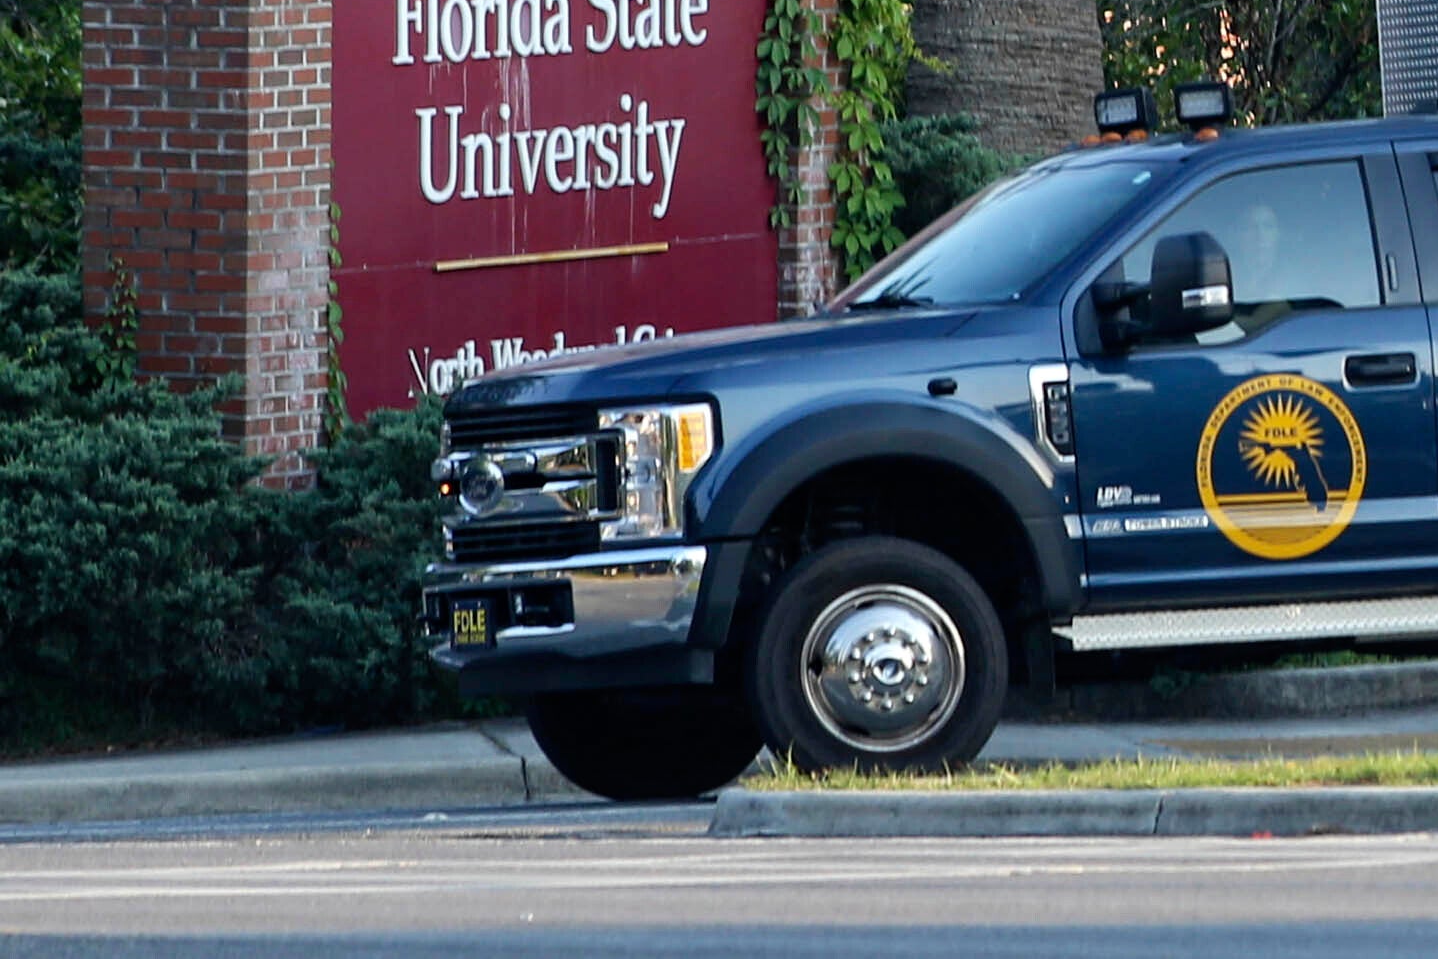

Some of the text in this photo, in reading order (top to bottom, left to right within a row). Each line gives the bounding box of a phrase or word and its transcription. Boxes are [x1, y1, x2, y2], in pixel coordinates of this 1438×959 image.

[415, 93, 685, 218] University
[1263, 426, 1298, 439] FDLE
[453, 608, 486, 634] FDLE
